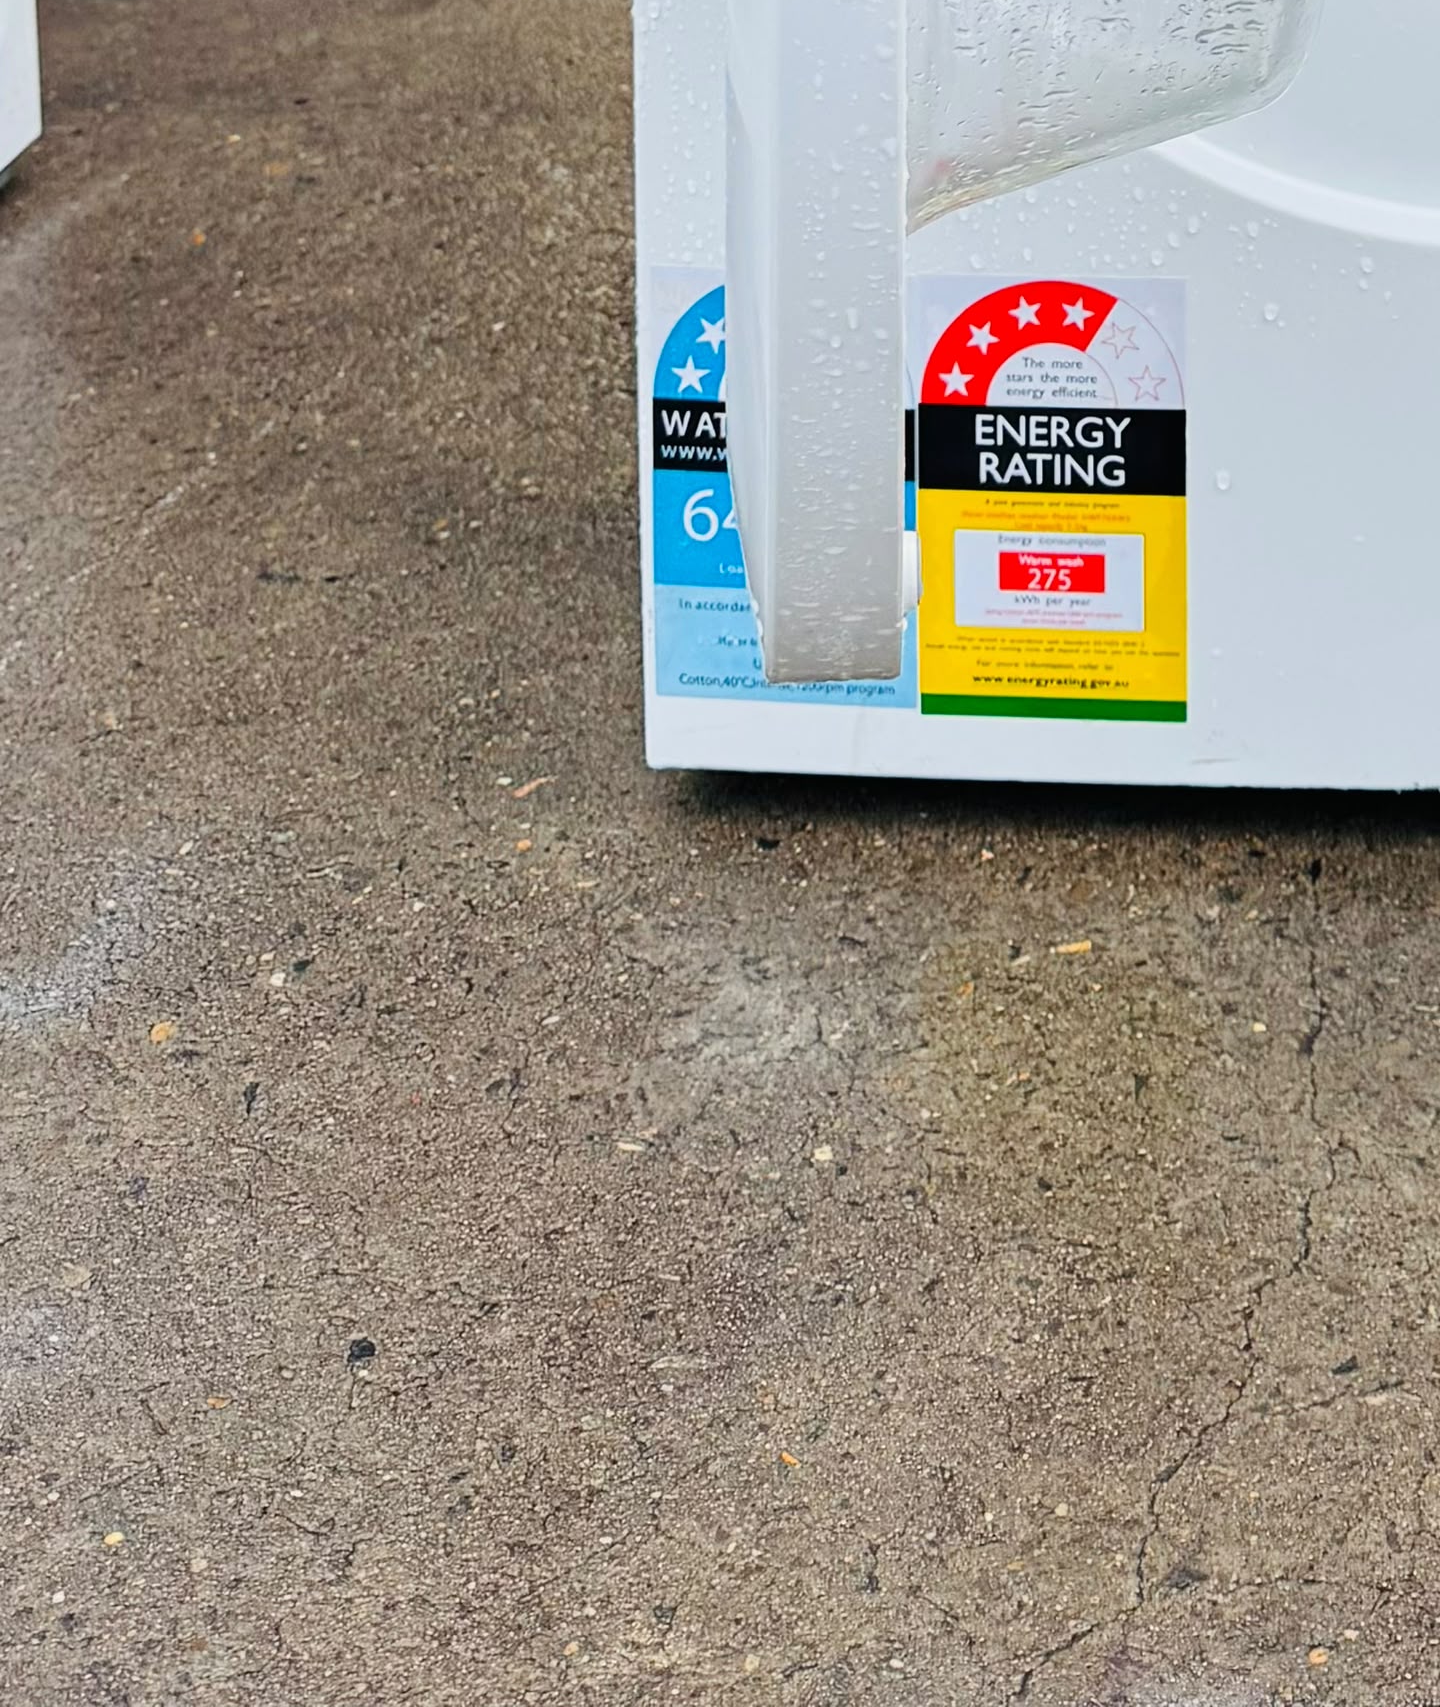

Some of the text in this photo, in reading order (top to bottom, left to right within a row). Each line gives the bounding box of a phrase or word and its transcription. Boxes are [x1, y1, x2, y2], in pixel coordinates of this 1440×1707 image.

[1022, 357, 1083, 369] The more
[1006, 372, 1098, 384] stars the more
[1006, 387, 1098, 399] energy efficient
[661, 410, 727, 439] WAT
[975, 413, 1131, 449] ENERGY
[979, 451, 1126, 487] RATING
[998, 534, 1106, 547] Energy consumption
[1018, 553, 1084, 567] Warm wash
[1028, 569, 1072, 591] 275
[679, 598, 692, 609] In
[1014, 595, 1091, 607] kWh per year
[846, 684, 896, 697] program
